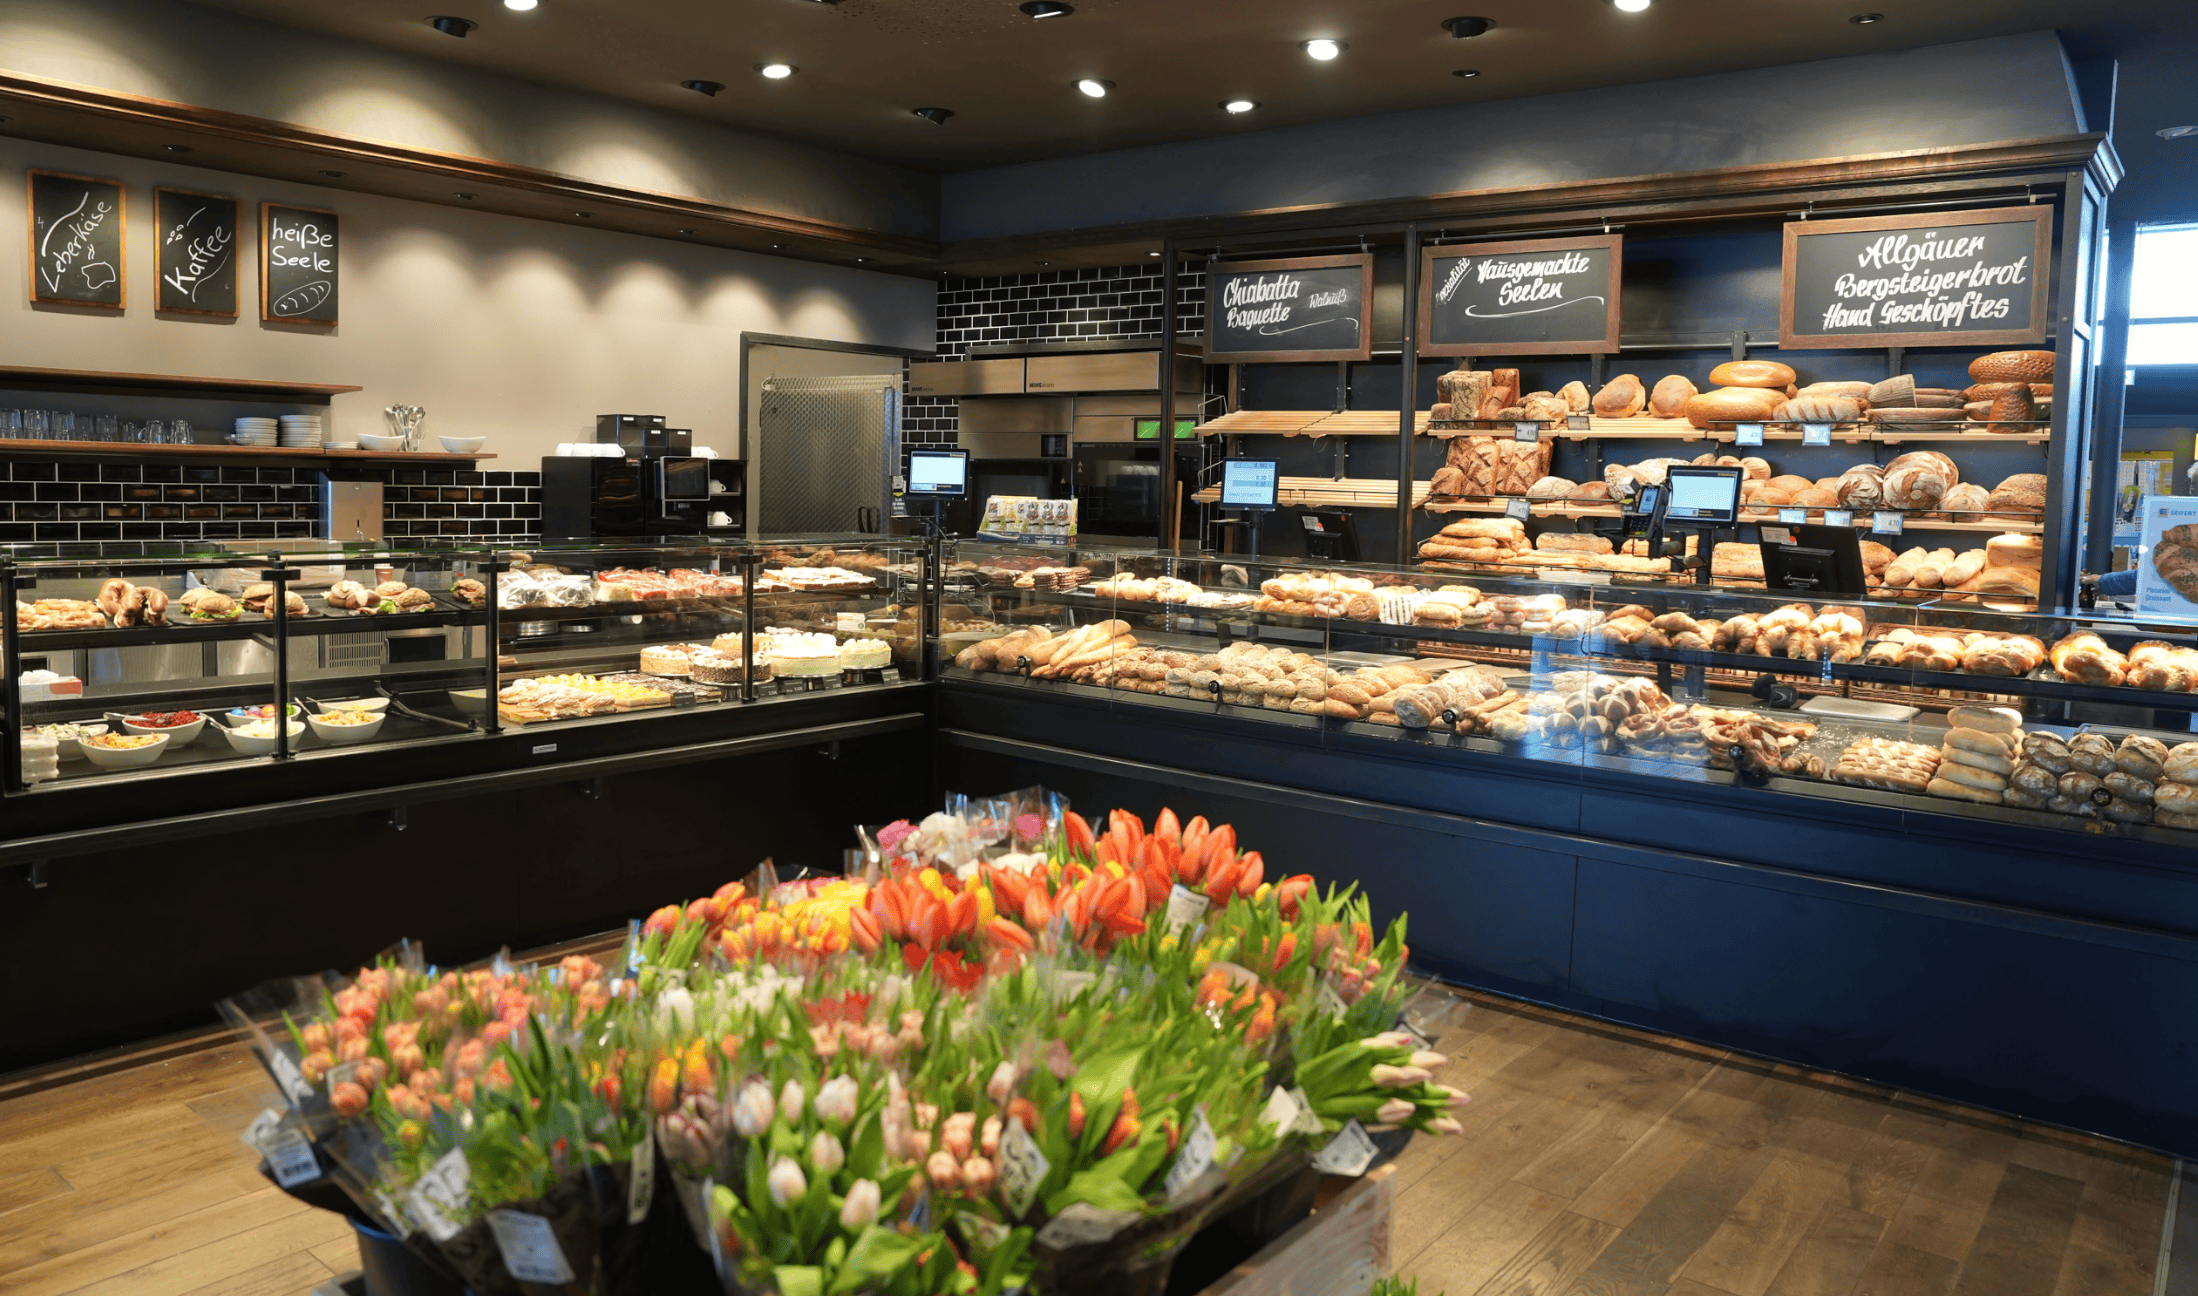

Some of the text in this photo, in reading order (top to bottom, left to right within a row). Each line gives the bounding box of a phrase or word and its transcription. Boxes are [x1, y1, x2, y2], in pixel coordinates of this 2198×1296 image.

[41, 200, 112, 293] Leberkäse
[271, 217, 334, 249] heiße
[1857, 231, 1985, 271] Allgäuer
[164, 225, 232, 295] Kaffee
[271, 245, 334, 273] Seele
[1223, 273, 1301, 309] Chiabatta
[1498, 277, 1563, 307] Seelen
[1834, 255, 2028, 301] Bergsteigerbrot
[1226, 302, 1291, 331] Baguette
[1822, 292, 2010, 331] Hand Geschöpftes
